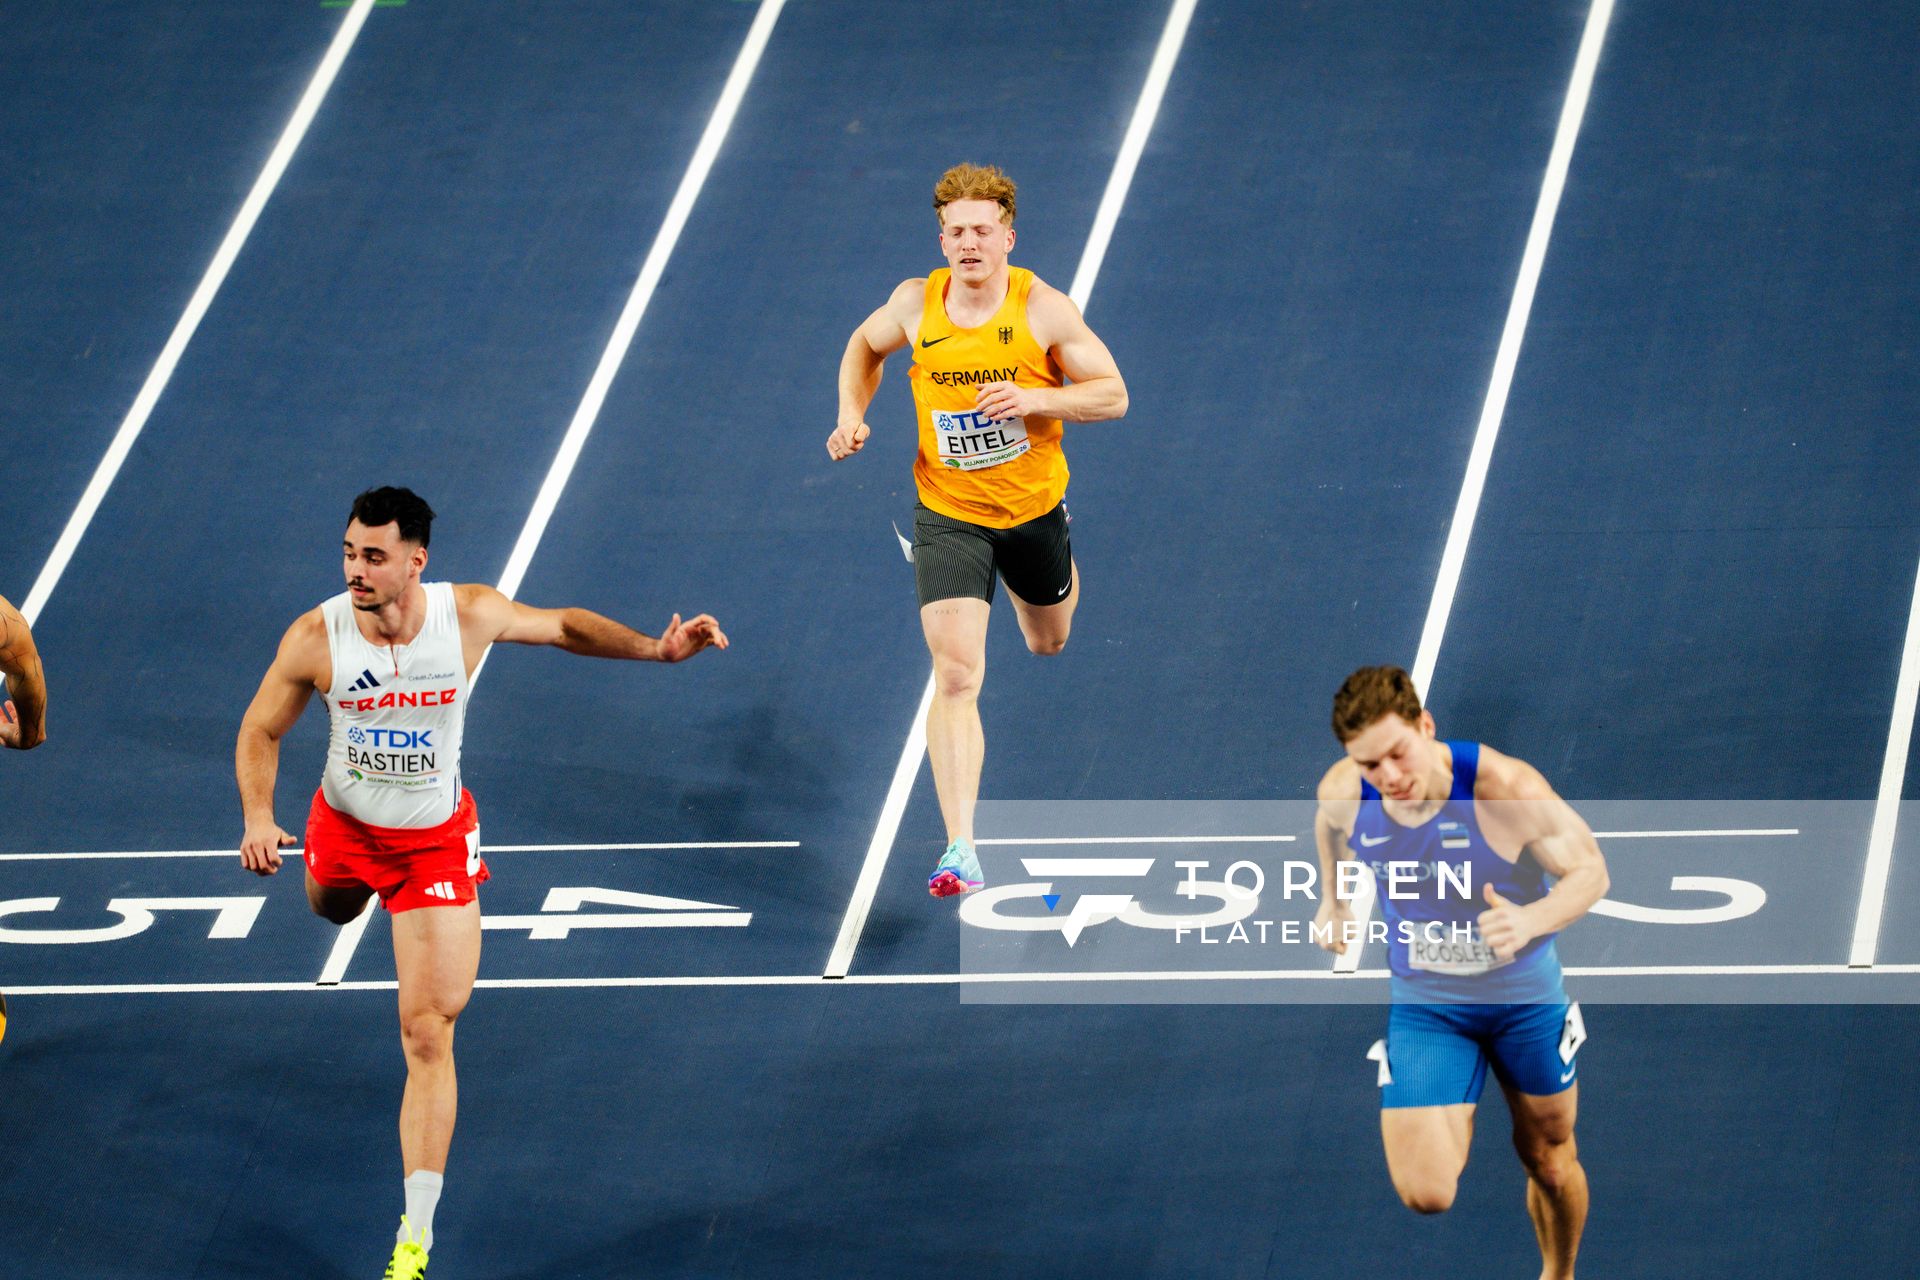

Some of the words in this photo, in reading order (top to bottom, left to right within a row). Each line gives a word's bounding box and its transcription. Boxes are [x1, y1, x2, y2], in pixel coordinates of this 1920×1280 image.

[931, 366, 1019, 387] GERMANY
[947, 430, 1015, 454] EITEL
[963, 458, 989, 467] KUJAWY
[338, 688, 457, 712] FRANCE
[366, 729, 433, 748] TDK
[348, 745, 435, 772] BASTIEN
[0, 895, 265, 944] 5
